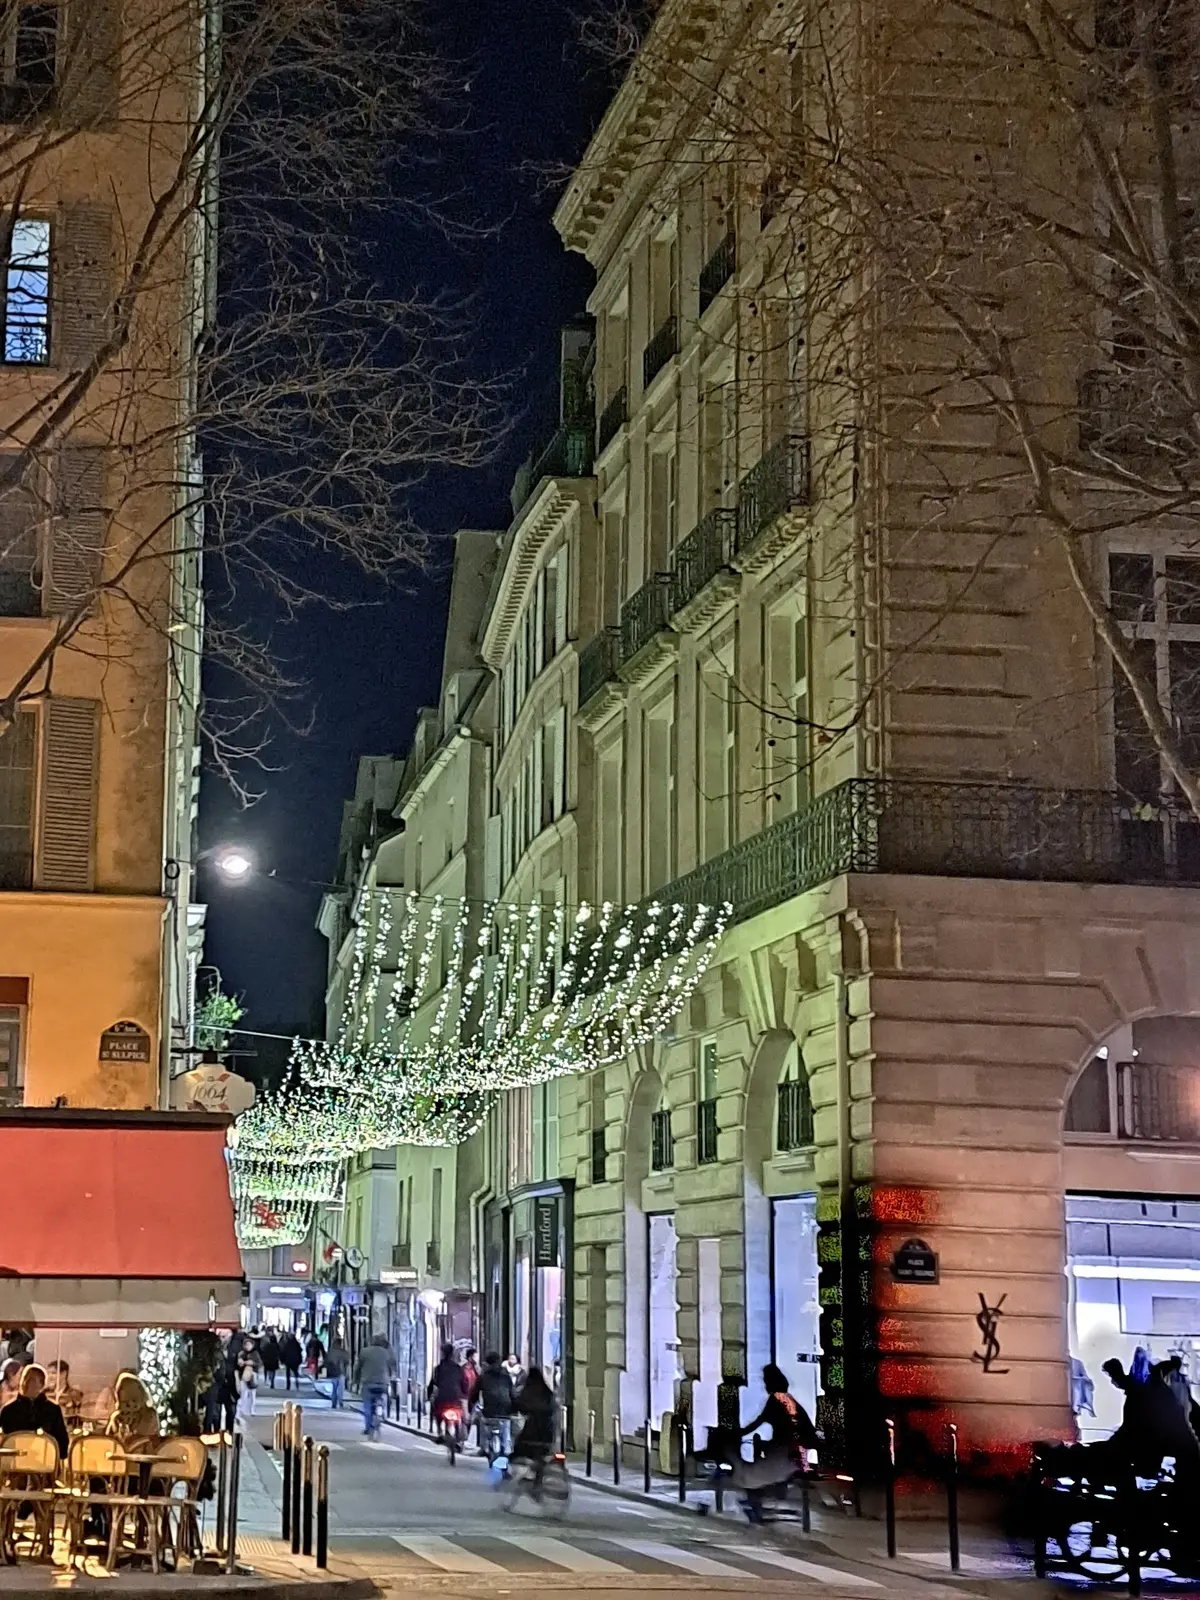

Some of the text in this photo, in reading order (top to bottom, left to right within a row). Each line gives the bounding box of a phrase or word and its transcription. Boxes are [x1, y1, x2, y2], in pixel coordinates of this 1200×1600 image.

[109, 1042, 138, 1050] PLACE
[111, 1051, 146, 1059] SULPICE
[538, 1207, 552, 1261] Hartford
